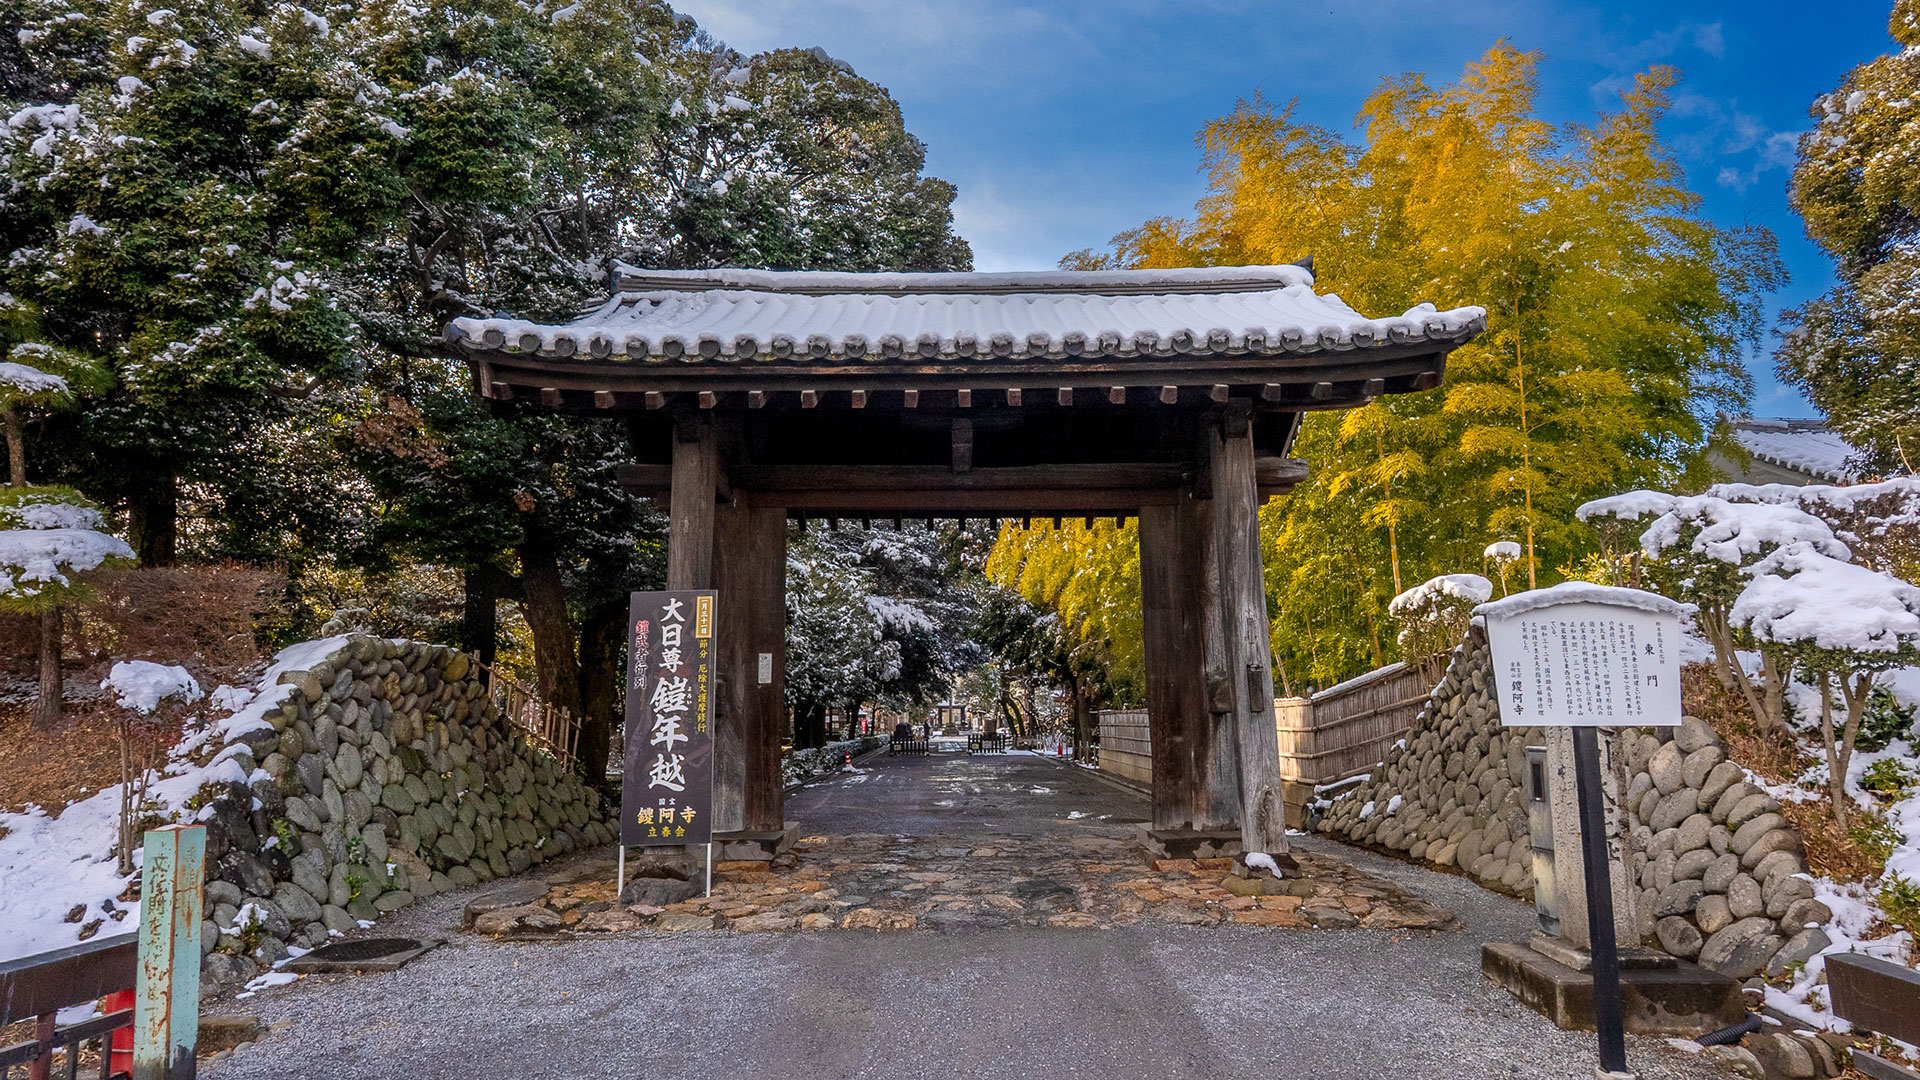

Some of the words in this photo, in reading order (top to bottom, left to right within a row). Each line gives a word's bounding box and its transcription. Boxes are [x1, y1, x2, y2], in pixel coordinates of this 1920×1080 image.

[700, 598, 708, 636] 一月三十一日
[633, 619, 650, 690] 鎧武者行列
[699, 639, 708, 659] 節分
[1645, 643, 1658, 687] 東門
[1512, 681, 1524, 715] 鑁阿寺
[637, 806, 697, 825] 鑁阿寺
[647, 826, 686, 838] 立春会
